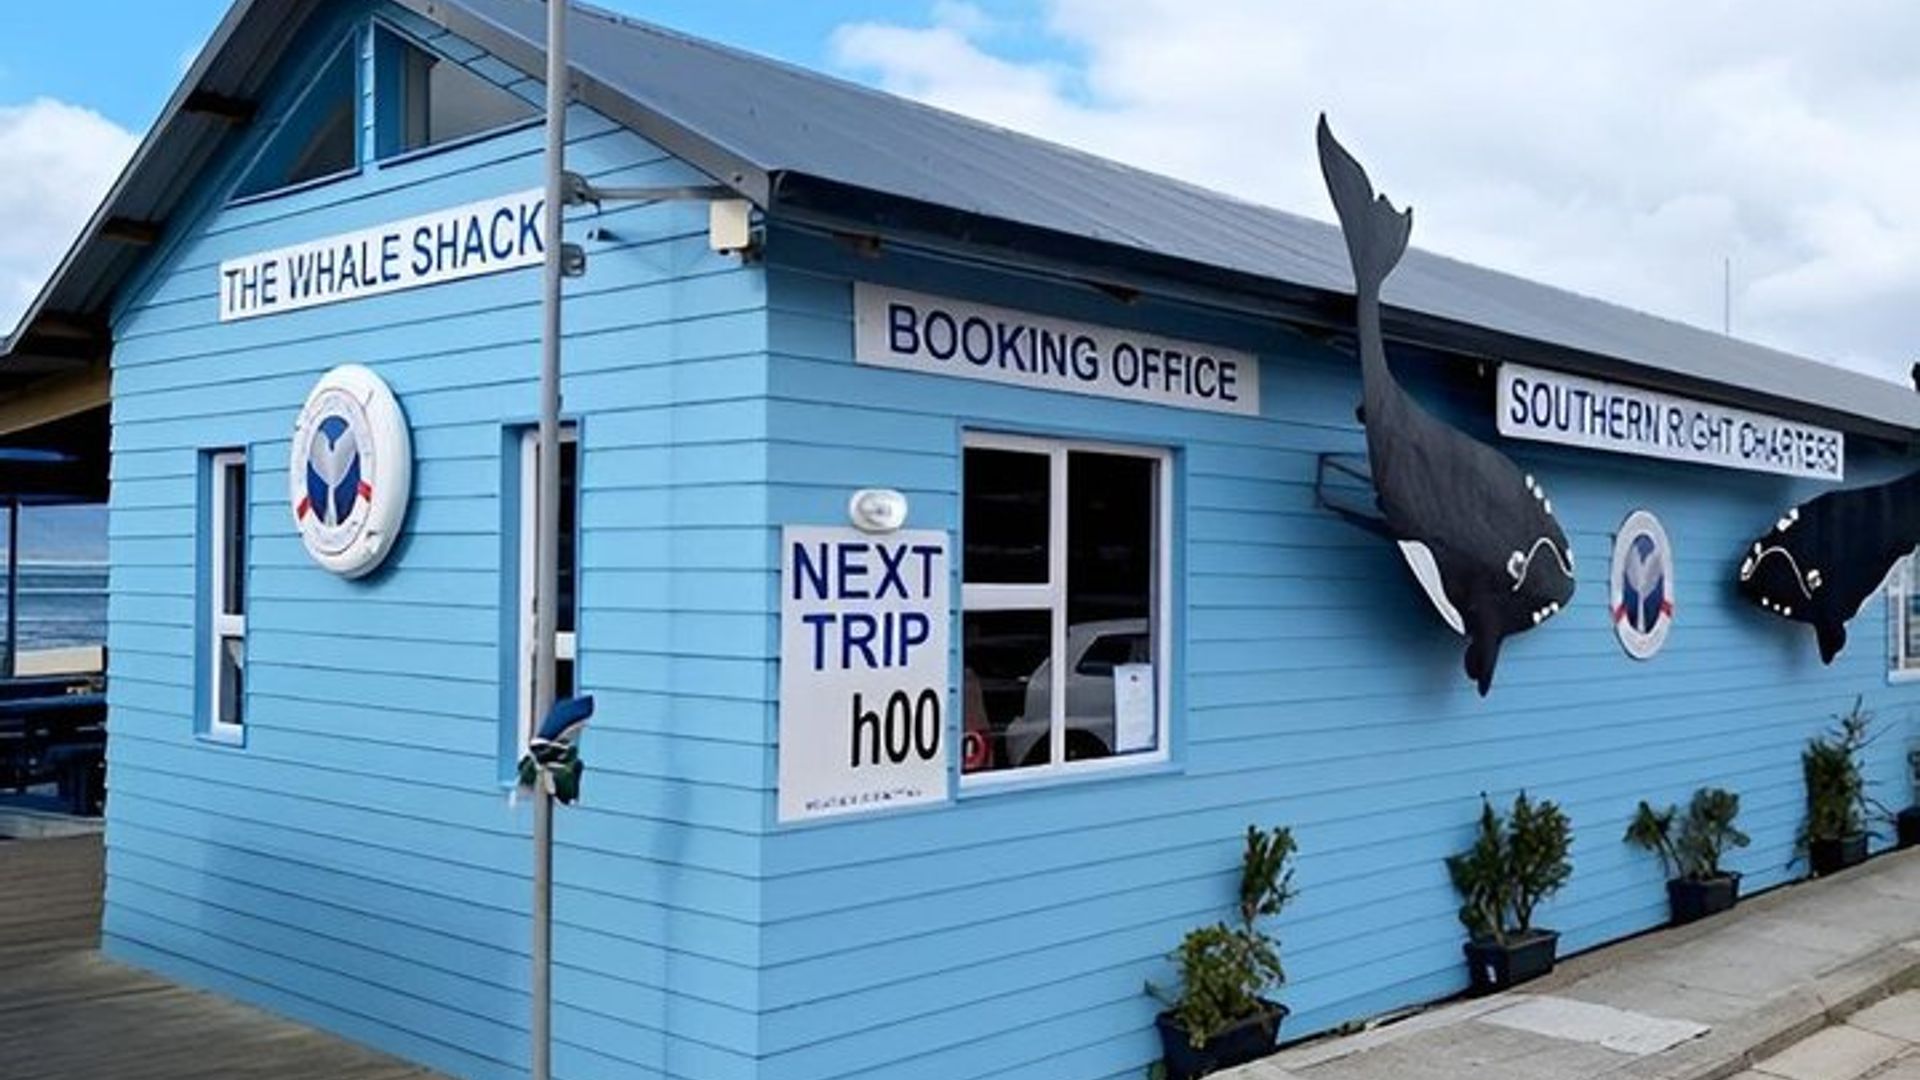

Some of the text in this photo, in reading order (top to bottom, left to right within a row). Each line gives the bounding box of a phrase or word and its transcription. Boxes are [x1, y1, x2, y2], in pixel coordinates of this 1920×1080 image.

[225, 199, 545, 312] THE WHALE SHACK
[889, 302, 1239, 402] BOOKING OFFICE
[1511, 378, 1660, 444] SOUTHERN
[1668, 408, 1734, 455] RGHT
[793, 541, 943, 600] NEXT
[802, 611, 931, 670] TRIP
[850, 688, 941, 768] h00
